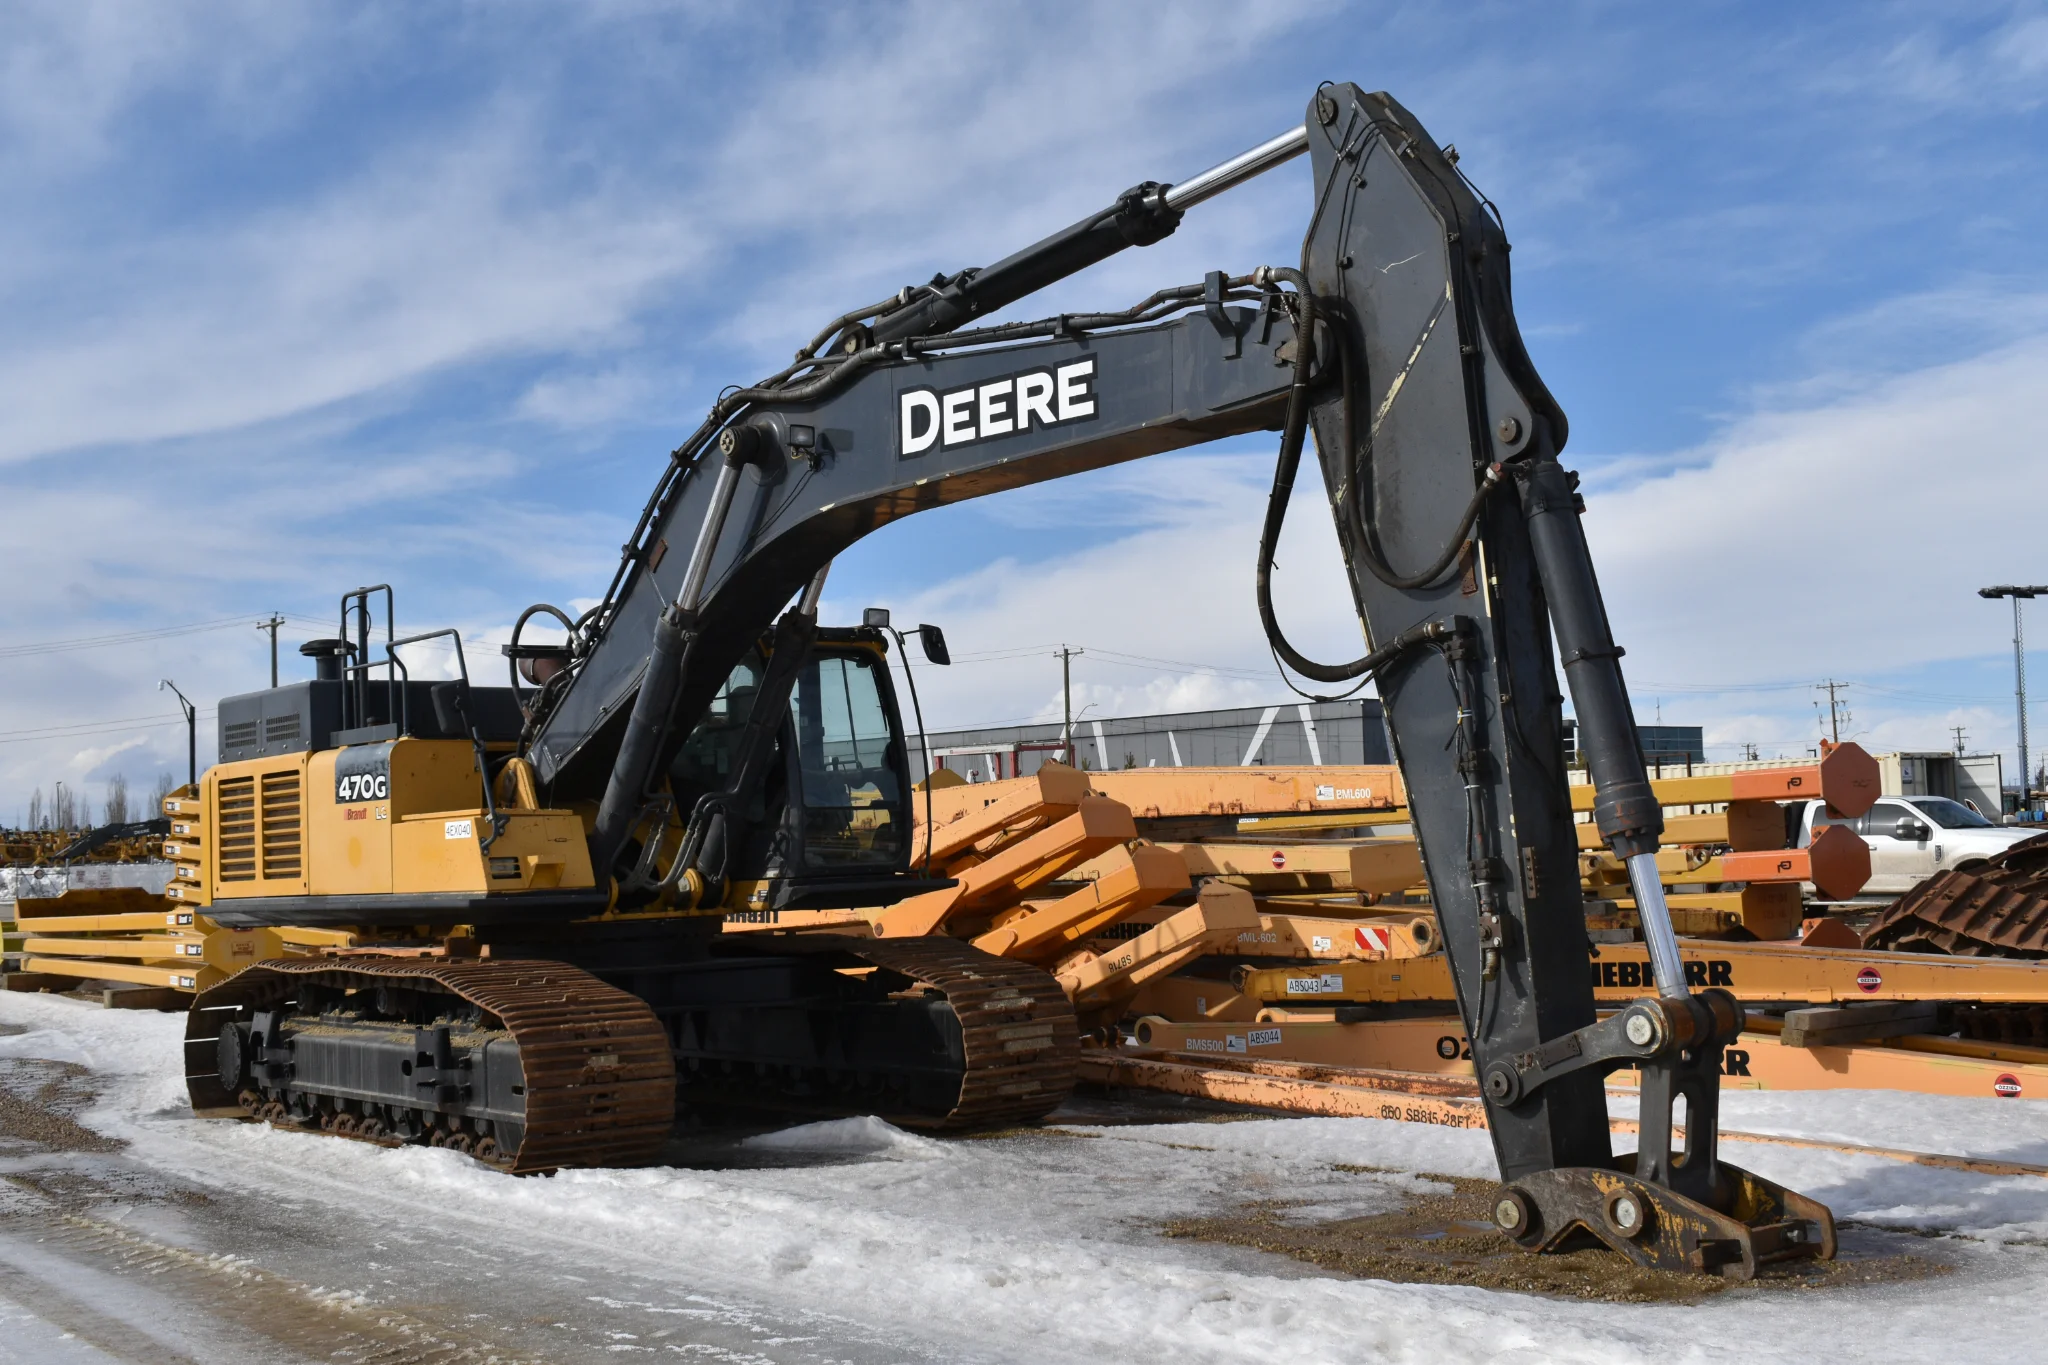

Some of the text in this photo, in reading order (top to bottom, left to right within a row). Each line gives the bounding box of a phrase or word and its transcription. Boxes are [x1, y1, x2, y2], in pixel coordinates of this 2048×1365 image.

[902, 360, 1094, 454] DEERE
[339, 774, 387, 800] 470G
[1336, 788, 1371, 800] BML600
[446, 823, 471, 837] 4EX040
[1237, 932, 1277, 943] BML-602
[1108, 954, 1132, 973] SB718
[1288, 980, 1319, 992] ABS043
[1250, 1030, 1279, 1044] ABS044
[1186, 1038, 1224, 1052] BMS500
